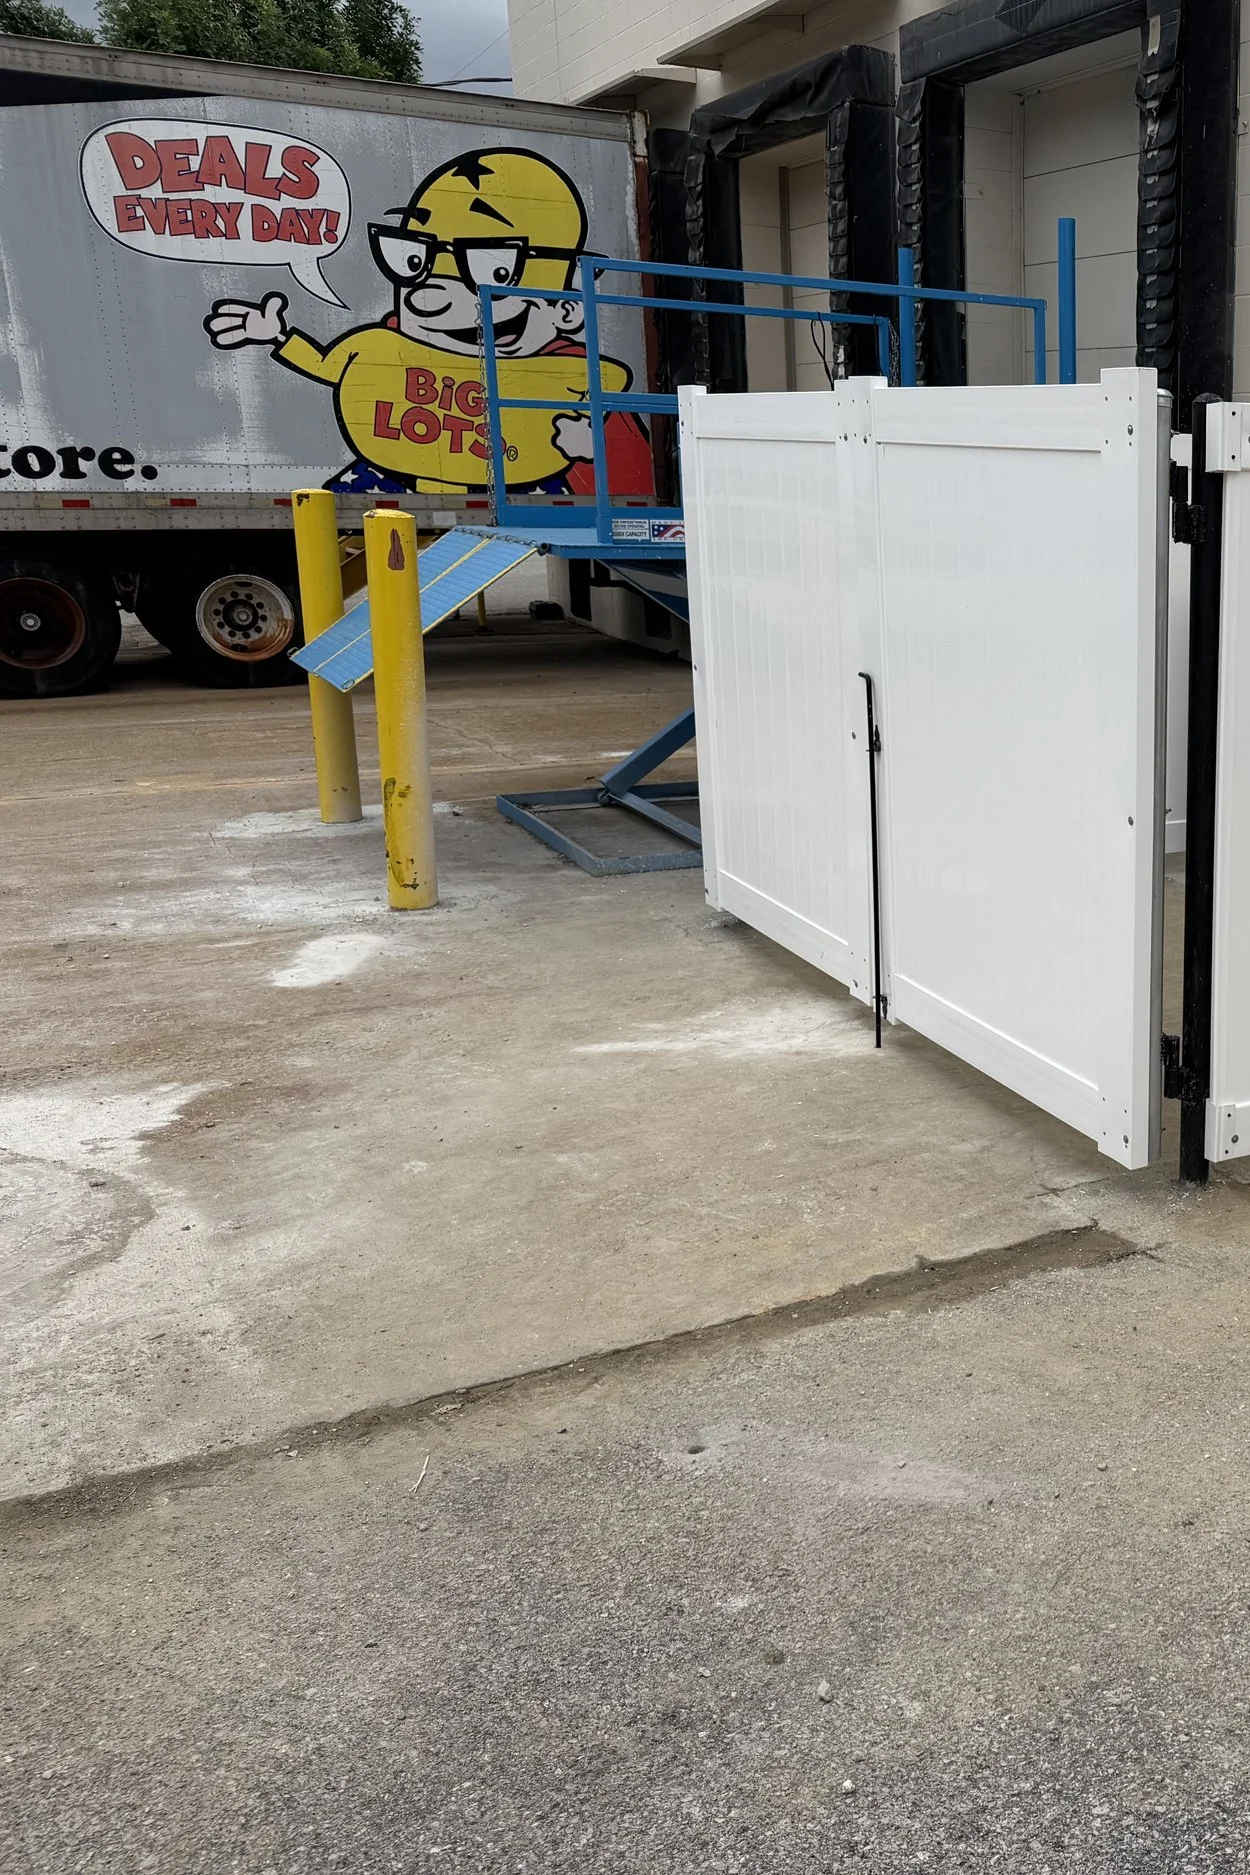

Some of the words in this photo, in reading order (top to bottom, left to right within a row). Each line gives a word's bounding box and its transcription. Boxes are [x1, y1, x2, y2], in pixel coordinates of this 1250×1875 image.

[104, 131, 320, 201] DEALS
[113, 194, 244, 240] EVERY
[250, 203, 341, 246] DAY!
